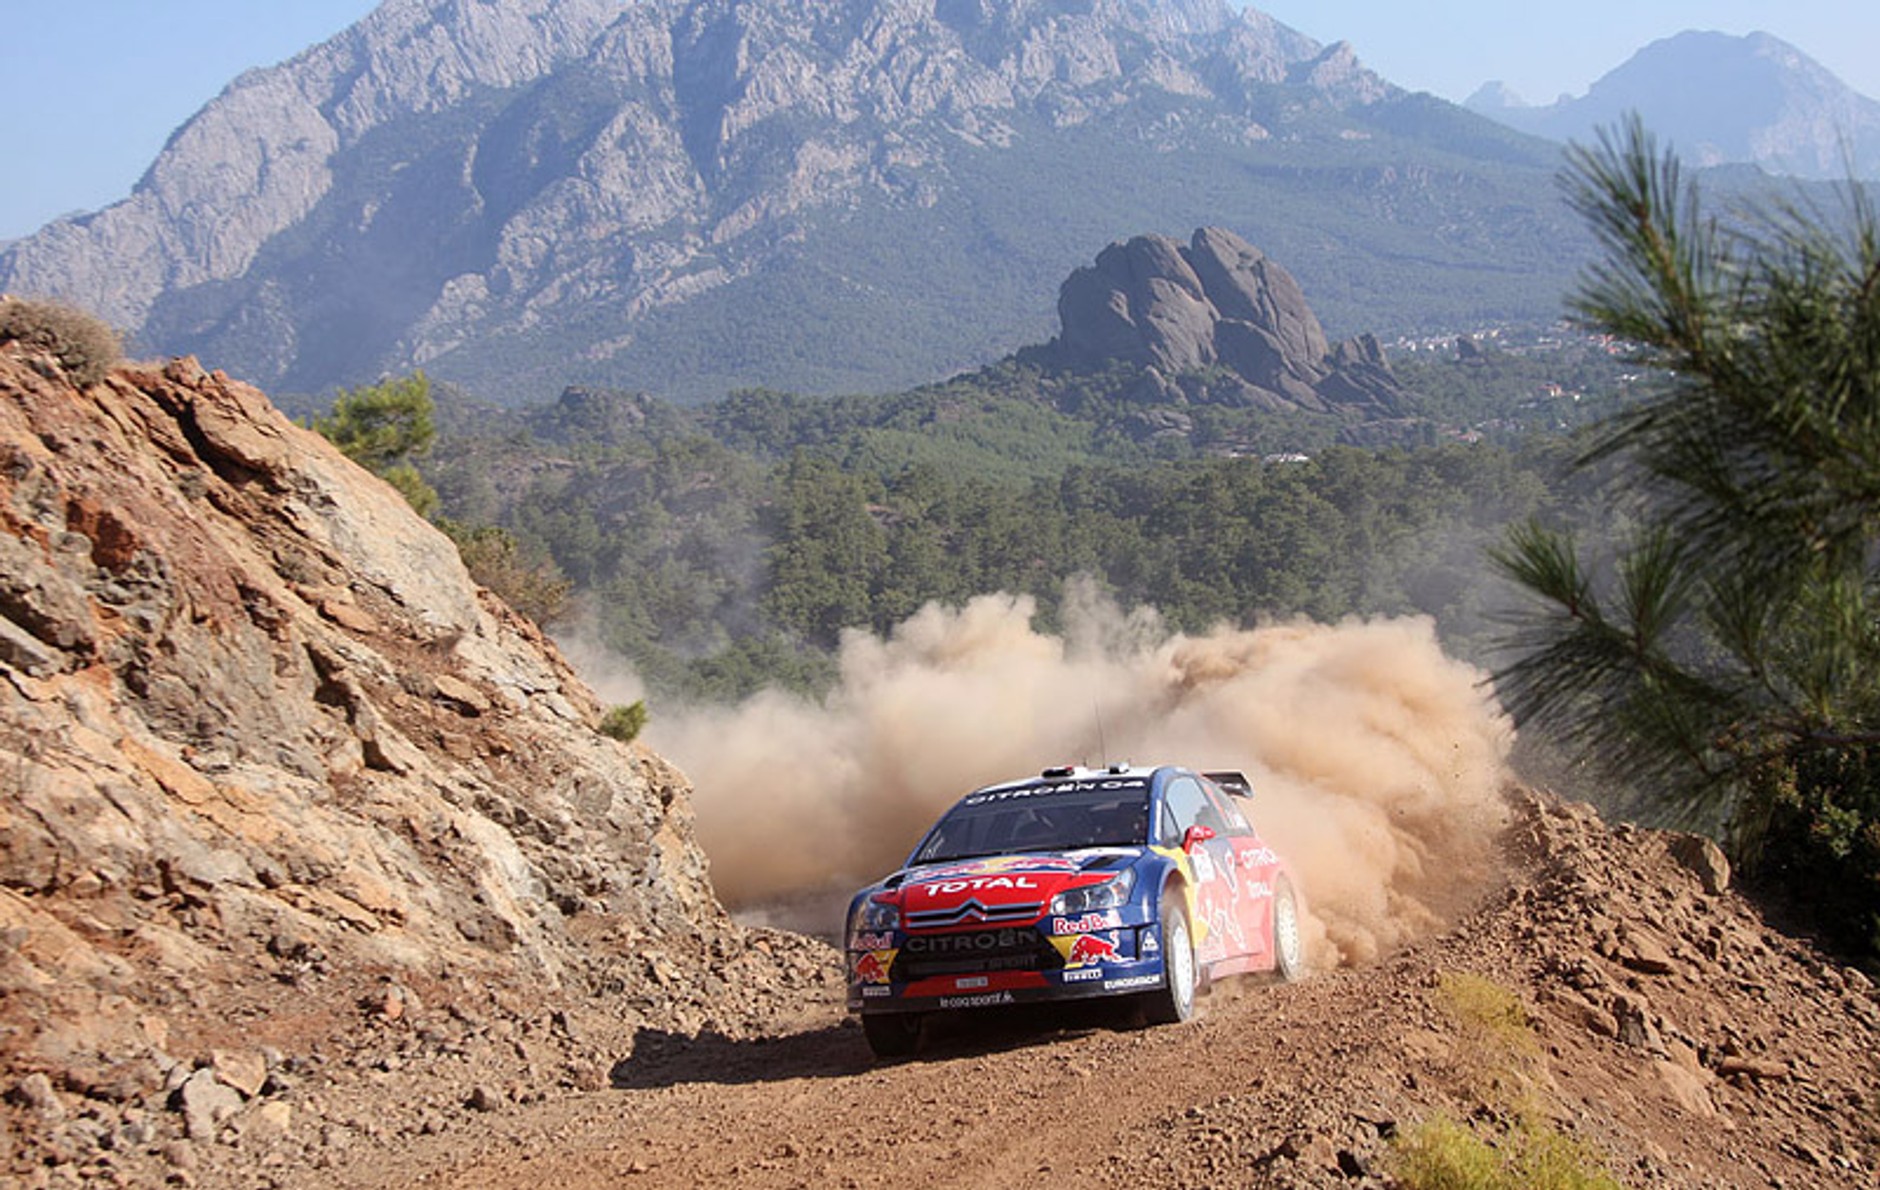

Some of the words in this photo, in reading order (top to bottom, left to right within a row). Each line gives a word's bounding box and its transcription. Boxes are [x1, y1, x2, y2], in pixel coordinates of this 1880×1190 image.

[966, 780, 1096, 806] CITROËN
[925, 876, 1038, 897] TOTAL
[1053, 915, 1091, 934] Red
[906, 928, 1038, 952] CITROËN
